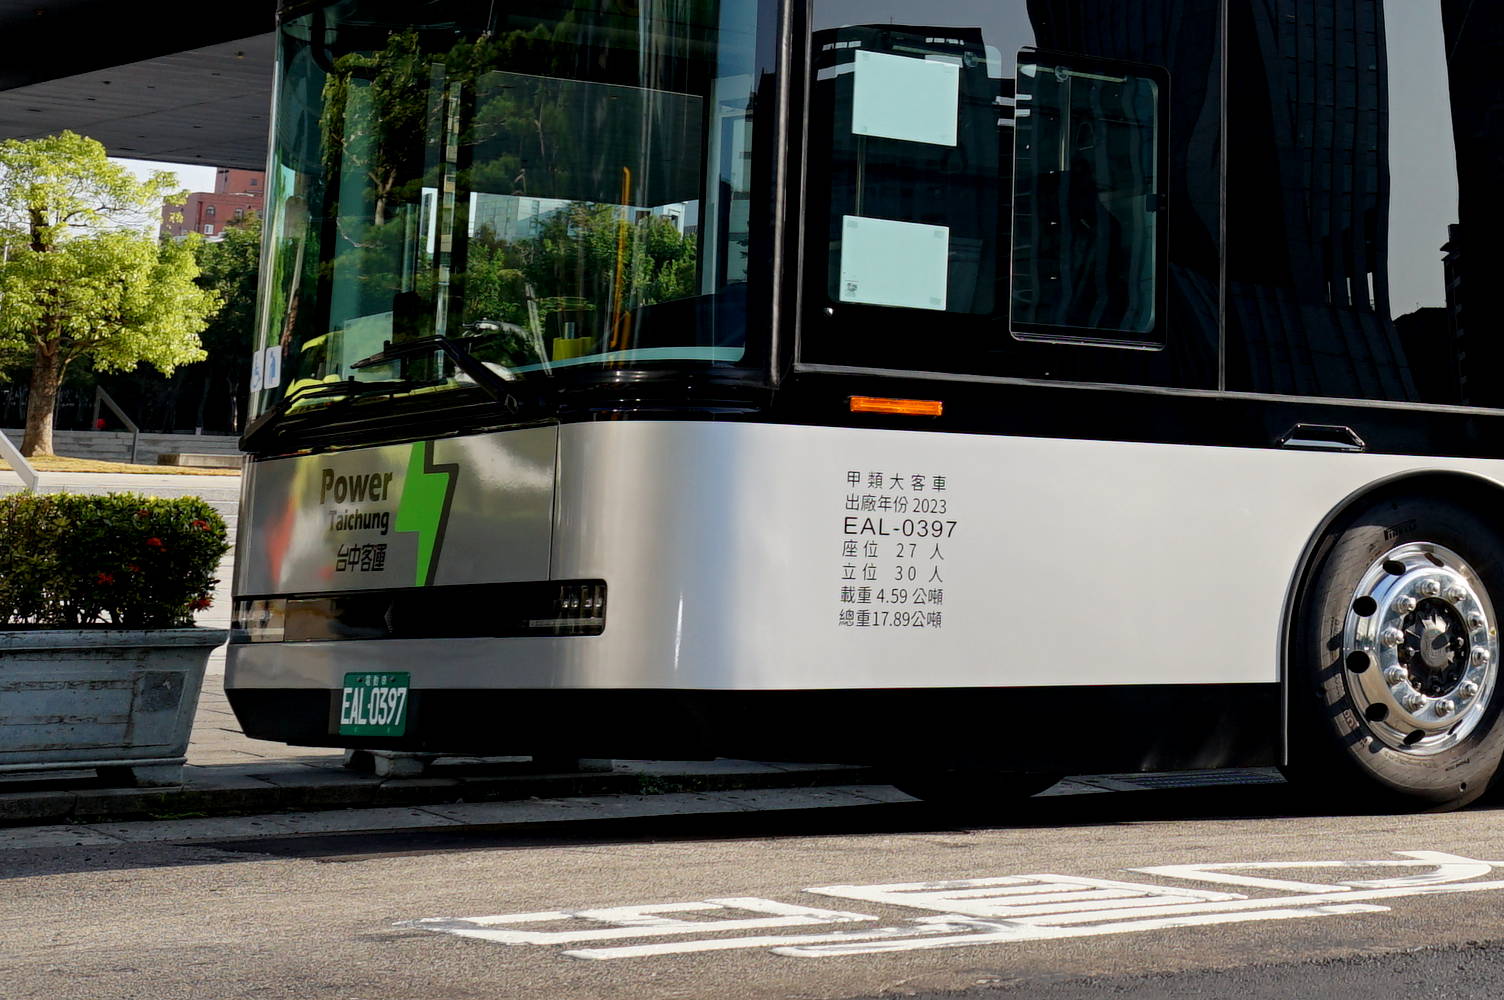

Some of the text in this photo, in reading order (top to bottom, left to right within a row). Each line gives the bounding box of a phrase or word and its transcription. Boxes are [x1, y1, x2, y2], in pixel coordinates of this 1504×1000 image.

[320, 468, 393, 505] Power
[847, 470, 947, 492] 甲類大客車
[845, 494, 947, 514] 出廠年份 2023
[328, 510, 390, 536] Taichung
[844, 516, 957, 538] EAL-0397
[335, 543, 388, 573] 台中客運
[842, 540, 944, 560] 座位 27 人
[841, 563, 943, 583] 立位 30 人
[840, 586, 943, 605] 載重 4.59 公噸
[340, 687, 407, 726] EAL-0397
